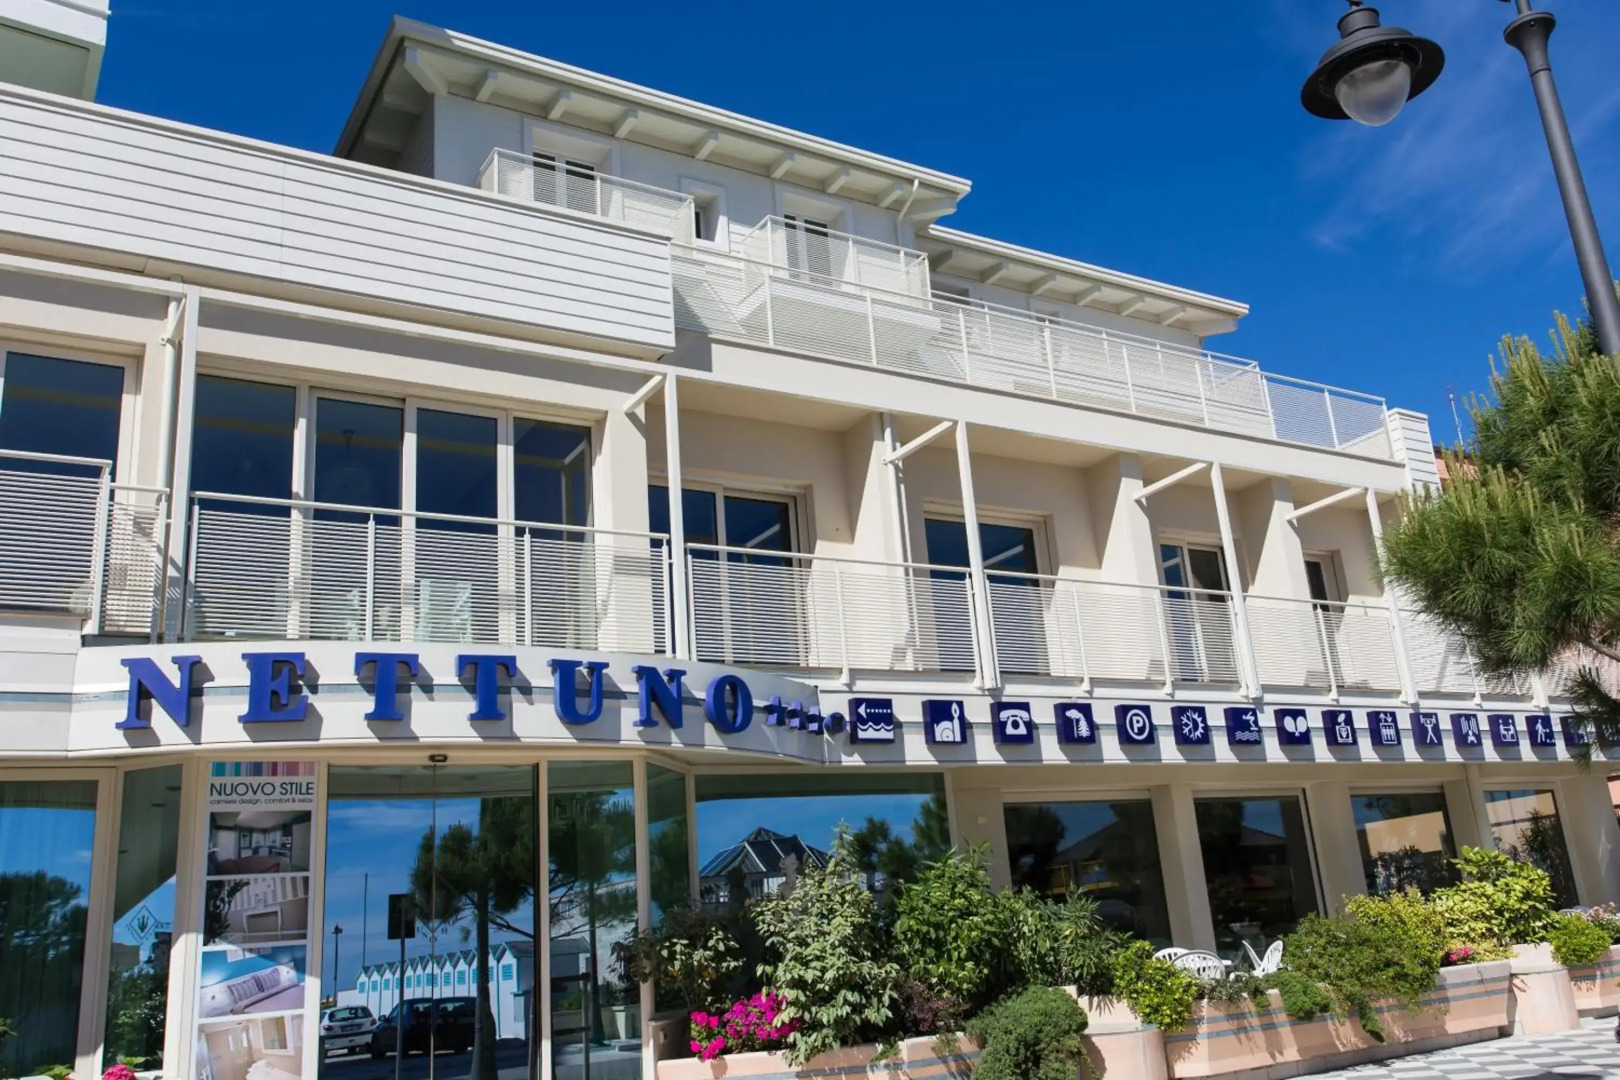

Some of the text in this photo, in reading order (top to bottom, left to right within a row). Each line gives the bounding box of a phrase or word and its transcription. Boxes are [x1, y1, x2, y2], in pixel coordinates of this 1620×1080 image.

[115, 652, 753, 733] NETTUNO
[1132, 716, 1143, 733] P
[209, 782, 314, 796] NUOVO STILE
